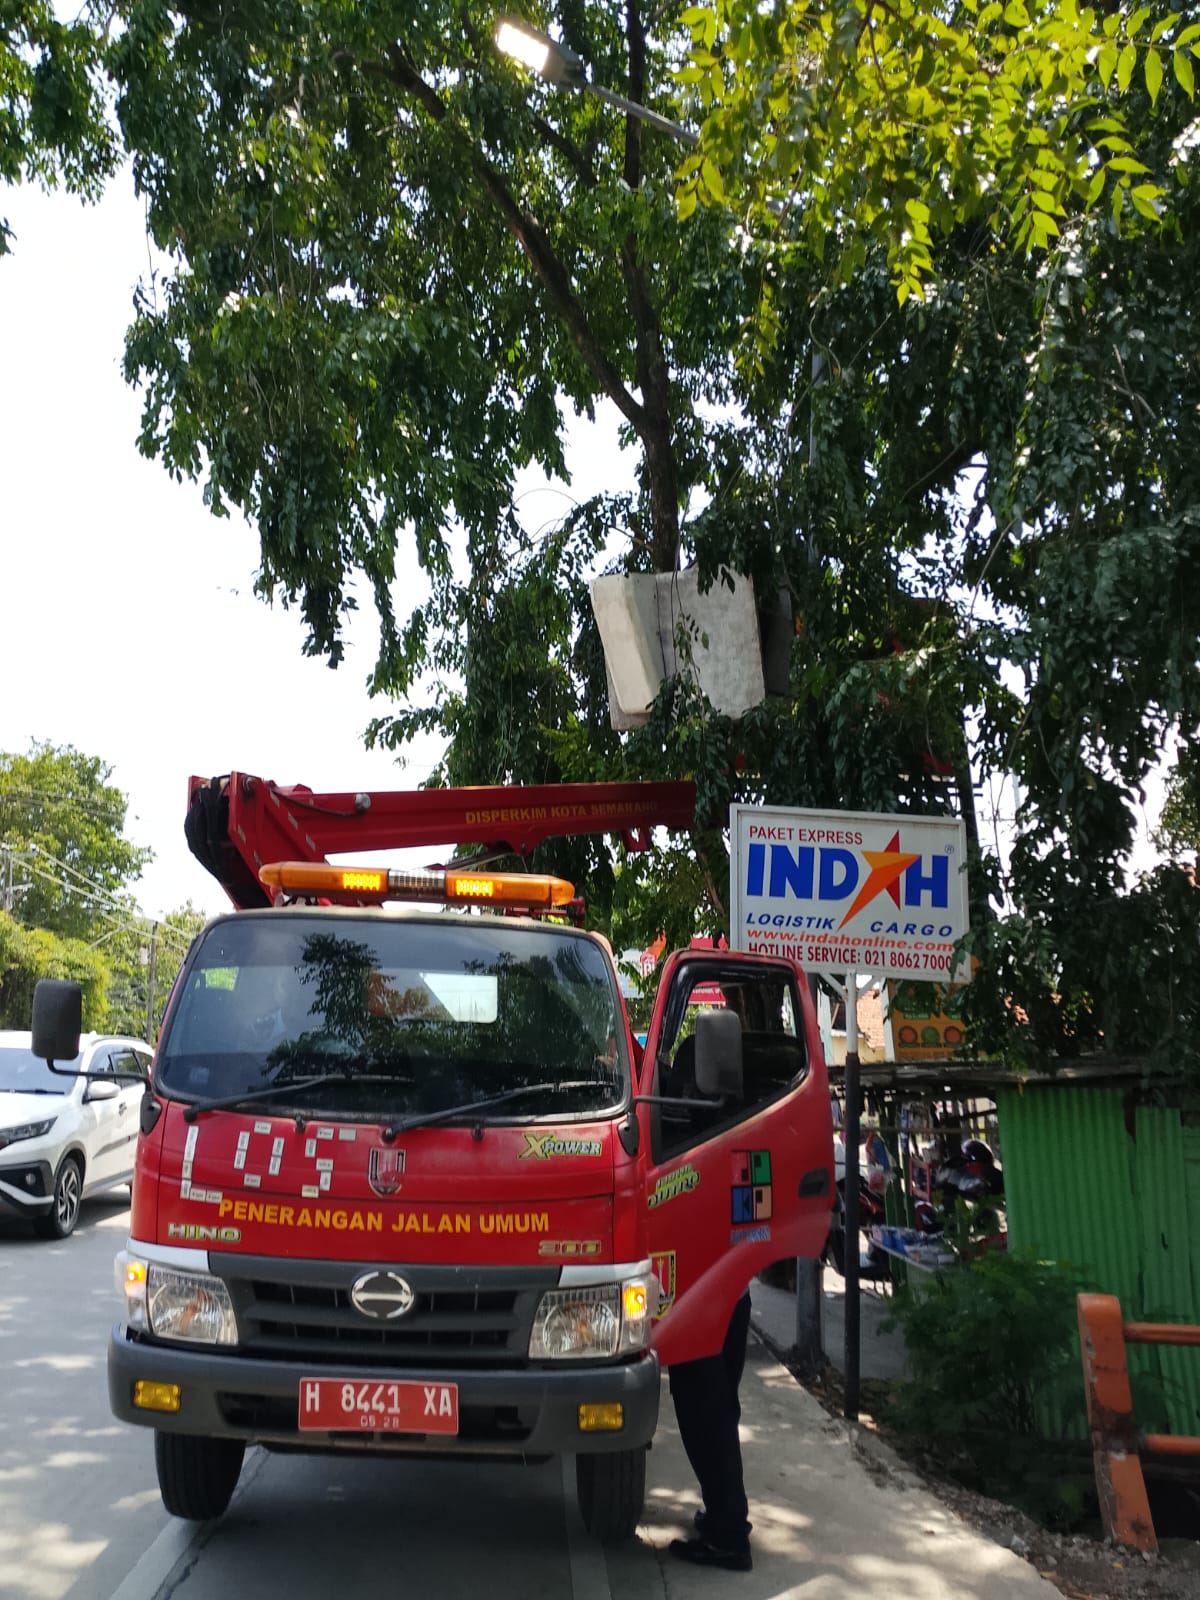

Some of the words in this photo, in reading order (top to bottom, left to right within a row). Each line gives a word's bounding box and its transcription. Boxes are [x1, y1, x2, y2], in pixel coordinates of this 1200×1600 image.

[465, 807, 547, 825] DISPERKIM
[551, 804, 587, 818] KOTA
[749, 825, 795, 840] PAKET
[799, 828, 863, 845] EXPRESS
[746, 912, 836, 931] LOGISTIK
[870, 920, 953, 937] CARGO
[747, 928, 954, 952] www.indahonline.com
[807, 945, 861, 965] SERVICE:
[865, 949, 886, 968] 021
[890, 951, 921, 969] 8062
[217, 1199, 384, 1232] PENERANGAN
[391, 1212, 471, 1233] JALAN
[478, 1211, 550, 1234] UMUM
[167, 1222, 242, 1243] HINO
[538, 1239, 602, 1257] 300
[305, 1382, 320, 1412] H
[341, 1383, 401, 1414] 8441
[423, 1386, 453, 1416] XA
